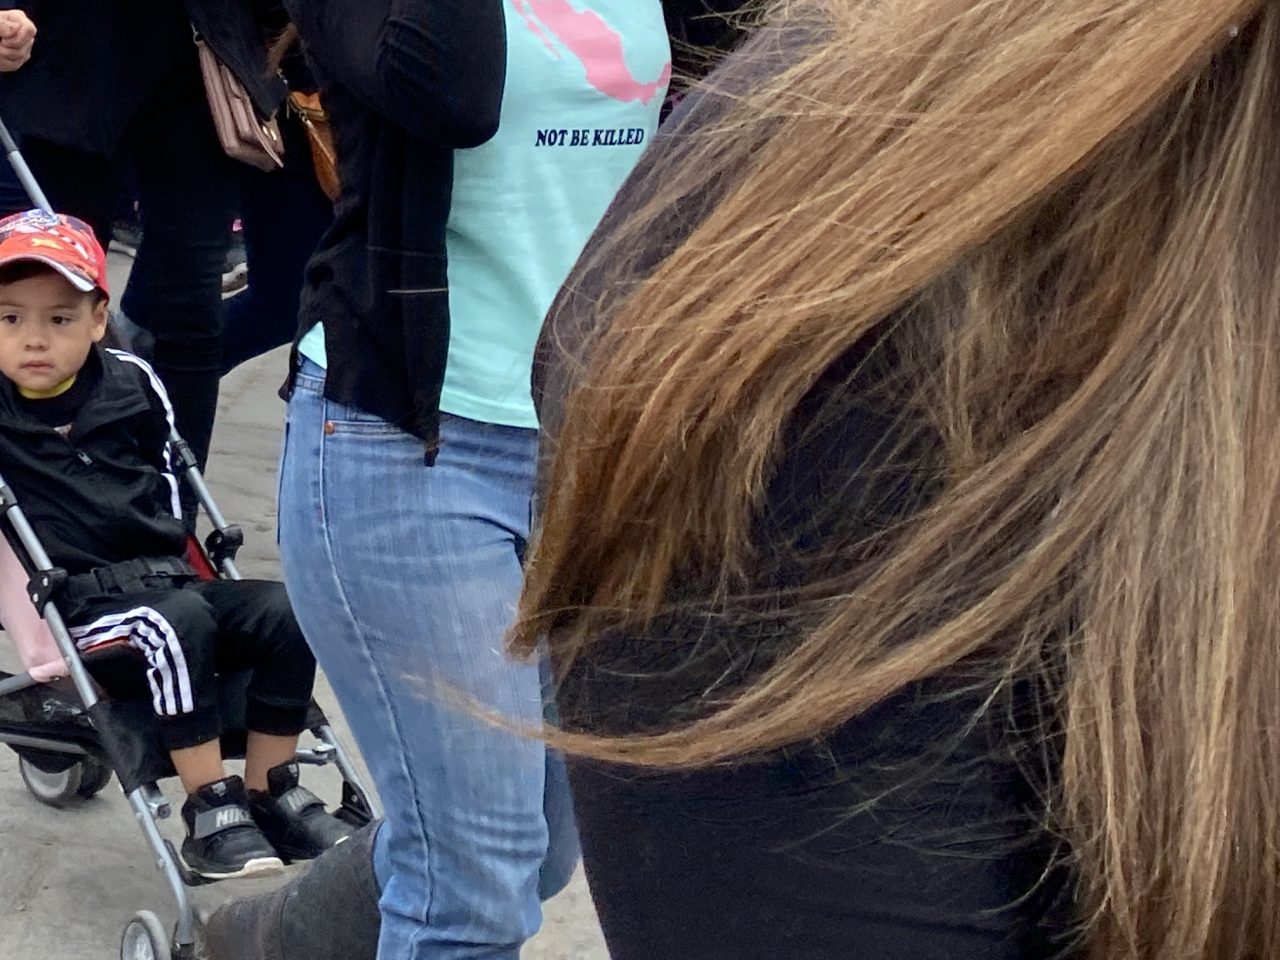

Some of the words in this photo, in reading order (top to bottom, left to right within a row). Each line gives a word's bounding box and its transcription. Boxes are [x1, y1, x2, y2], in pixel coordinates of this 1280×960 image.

[535, 128, 569, 147] NOT
[569, 128, 589, 147] BE
[591, 128, 645, 147] KILLED
